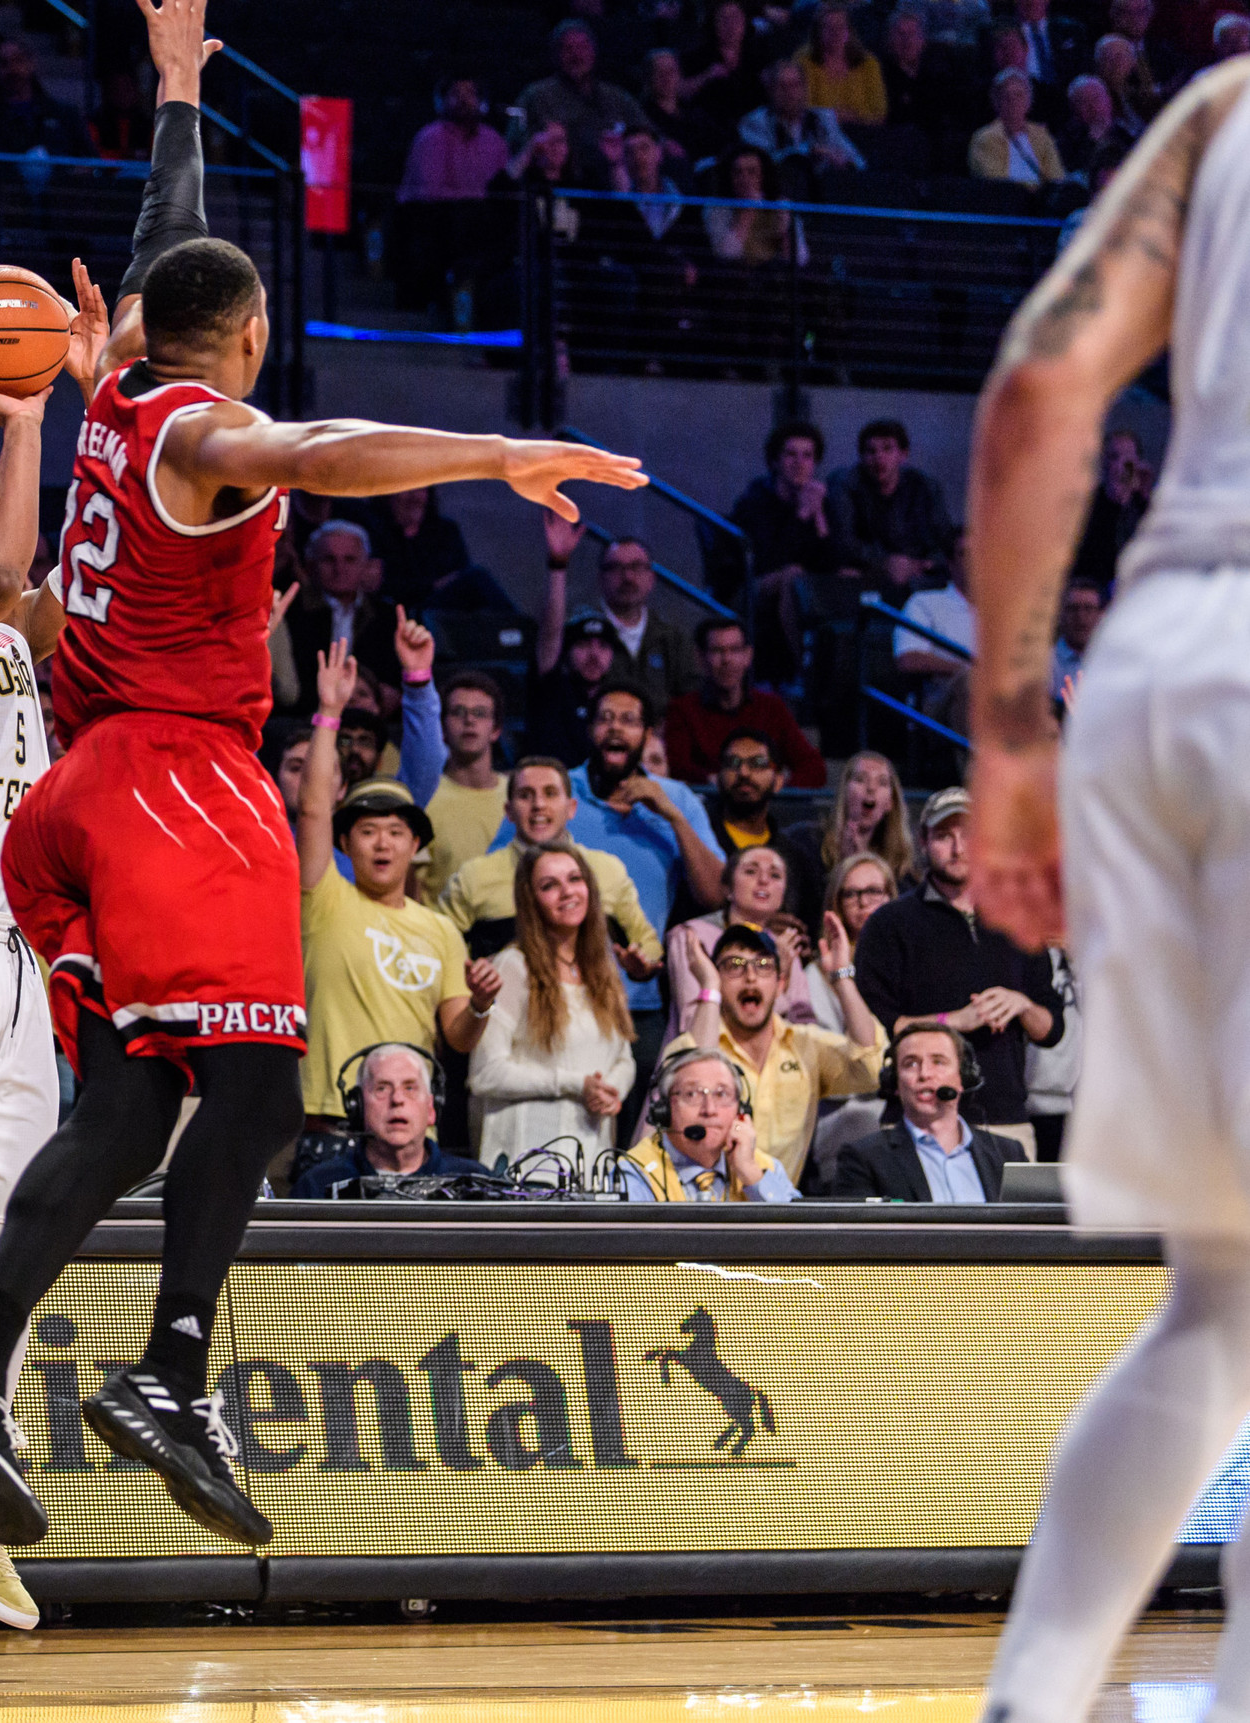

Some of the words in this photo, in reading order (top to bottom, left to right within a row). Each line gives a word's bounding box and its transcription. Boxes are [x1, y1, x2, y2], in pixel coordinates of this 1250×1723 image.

[58, 478, 120, 624] 12
[14, 710, 26, 767] 5
[199, 1001, 297, 1036] PACK
